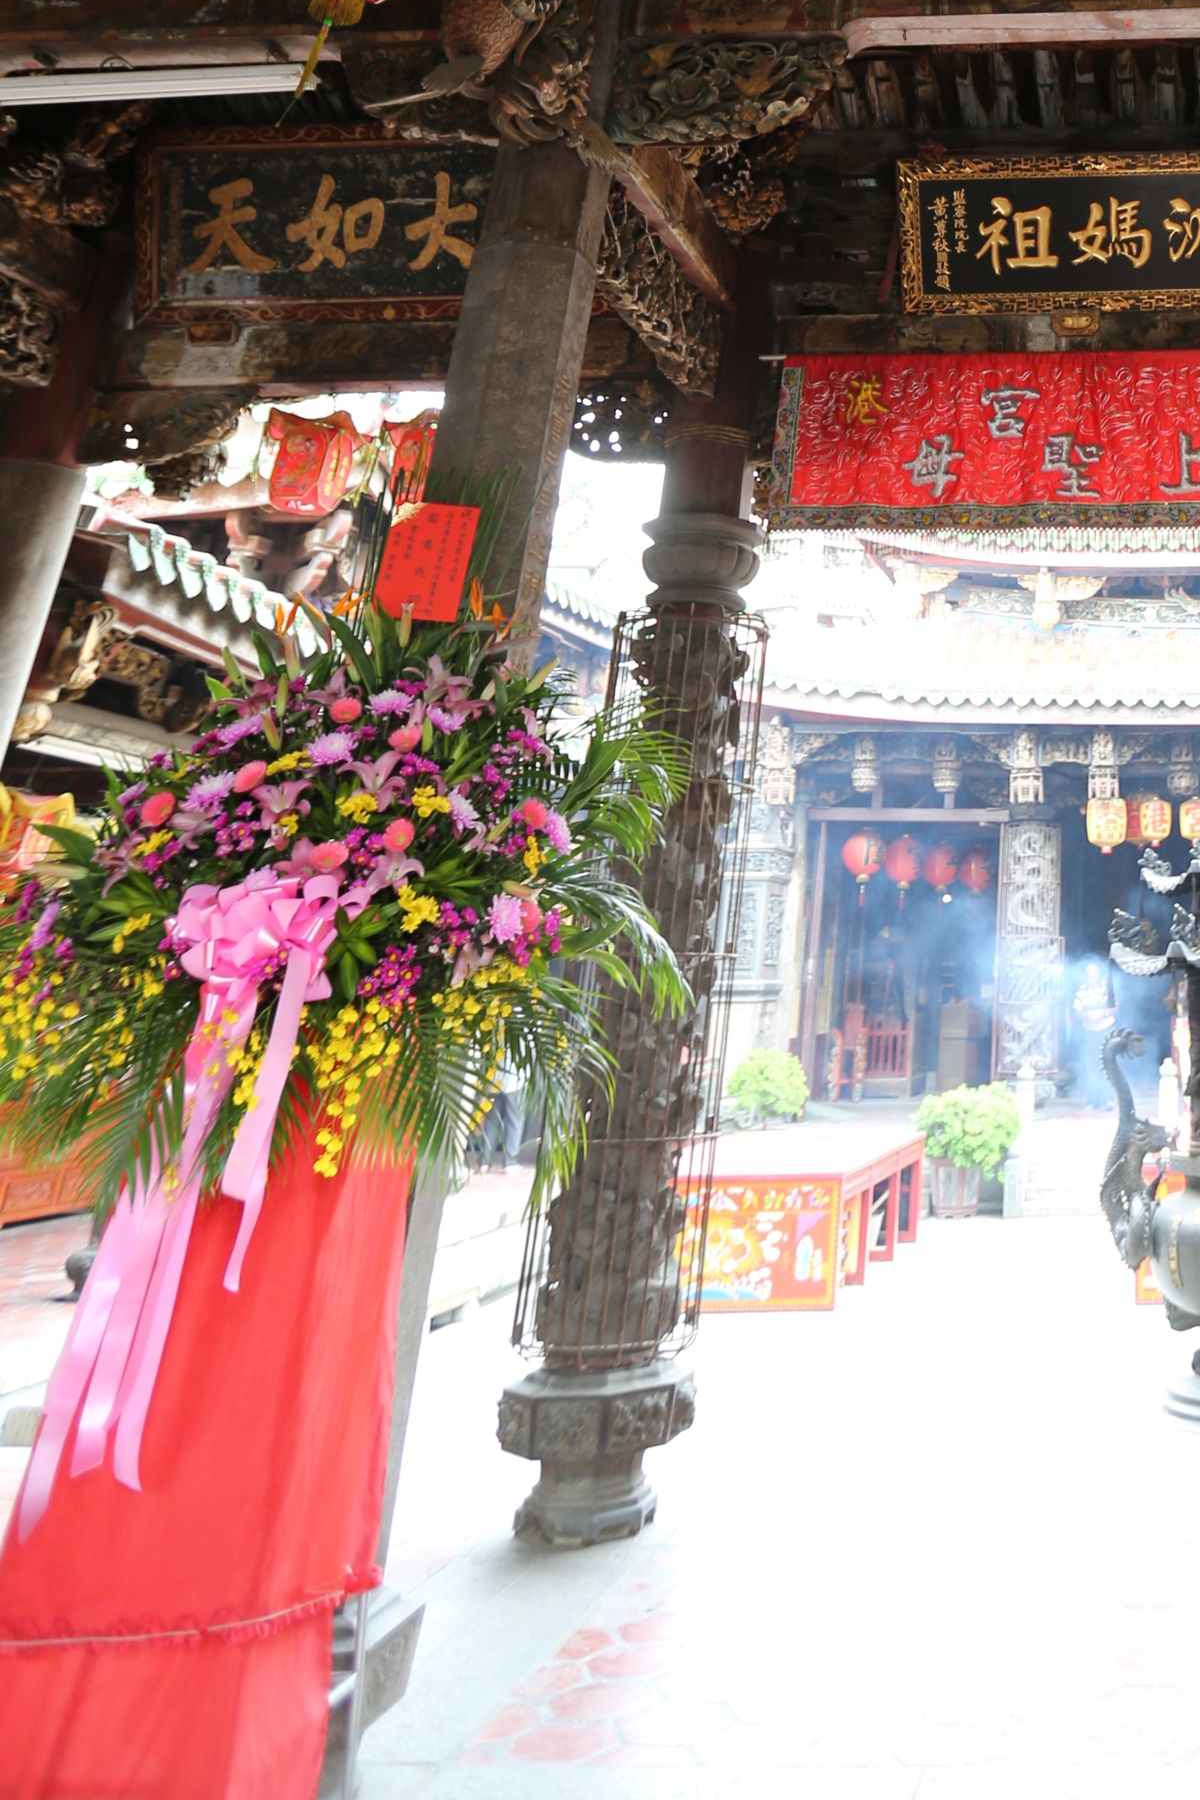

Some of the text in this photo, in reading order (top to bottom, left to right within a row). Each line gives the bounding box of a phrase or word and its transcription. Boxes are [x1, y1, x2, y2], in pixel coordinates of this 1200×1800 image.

[189, 170, 479, 272] 大如天
[844, 380, 887, 425] 港
